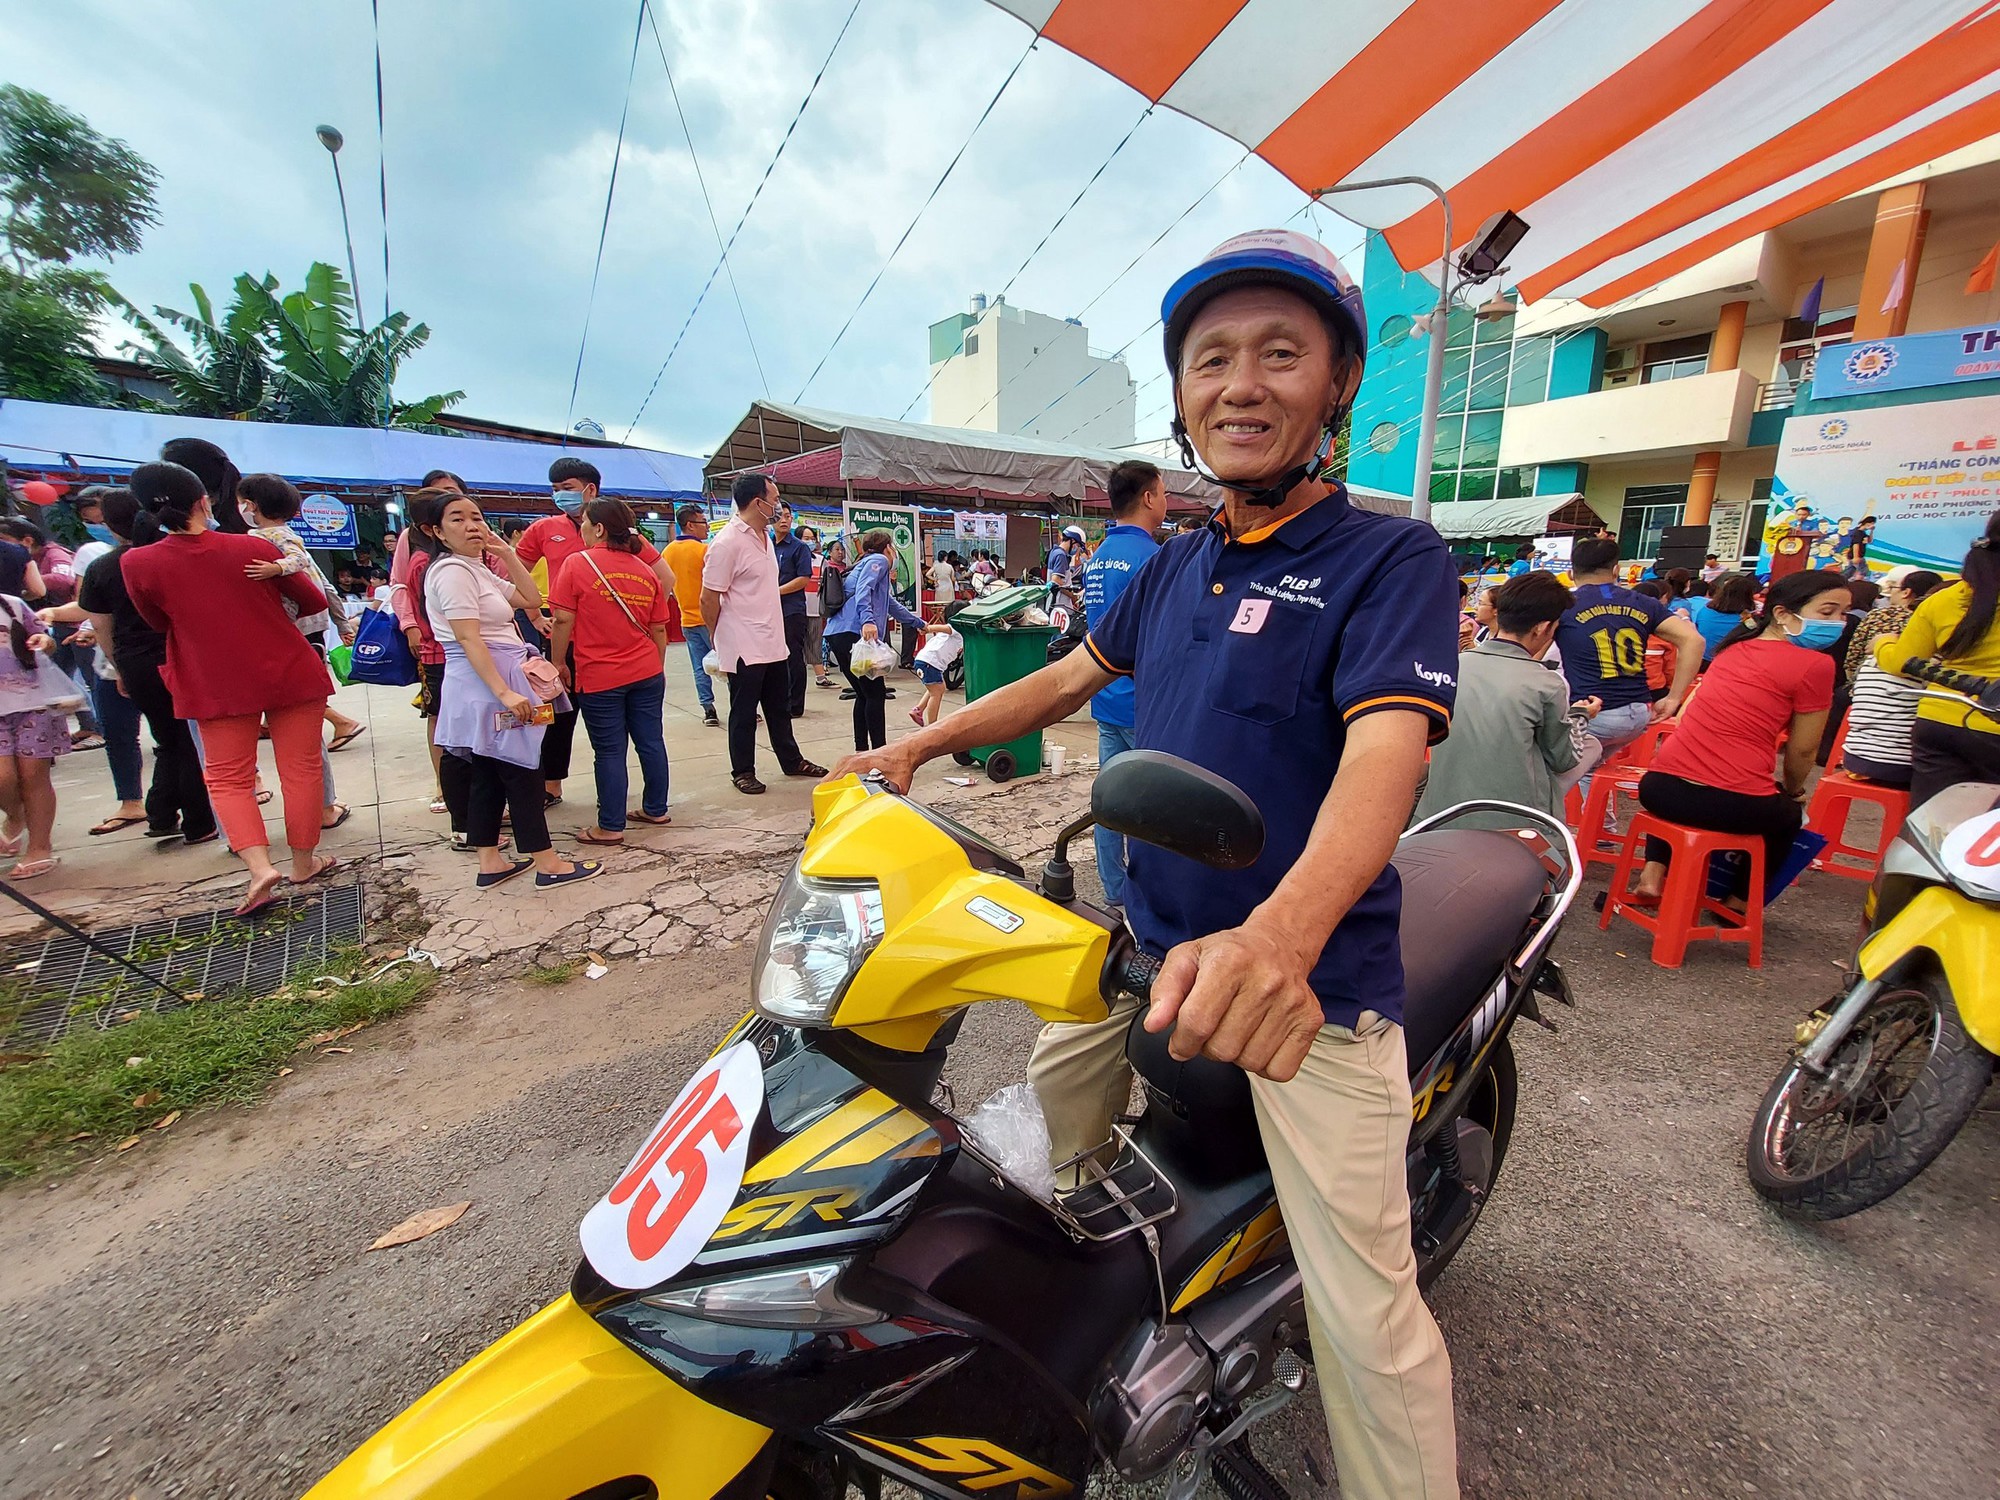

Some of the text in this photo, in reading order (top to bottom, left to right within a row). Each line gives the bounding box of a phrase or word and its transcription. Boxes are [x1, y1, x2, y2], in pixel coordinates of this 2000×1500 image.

[1279, 575, 1309, 590] PLB
[1054, 611, 1067, 632] 06
[1241, 607, 1254, 625] 5
[358, 644, 381, 655] CEP
[1589, 627, 1645, 679] 10
[609, 1069, 743, 1262] 05
